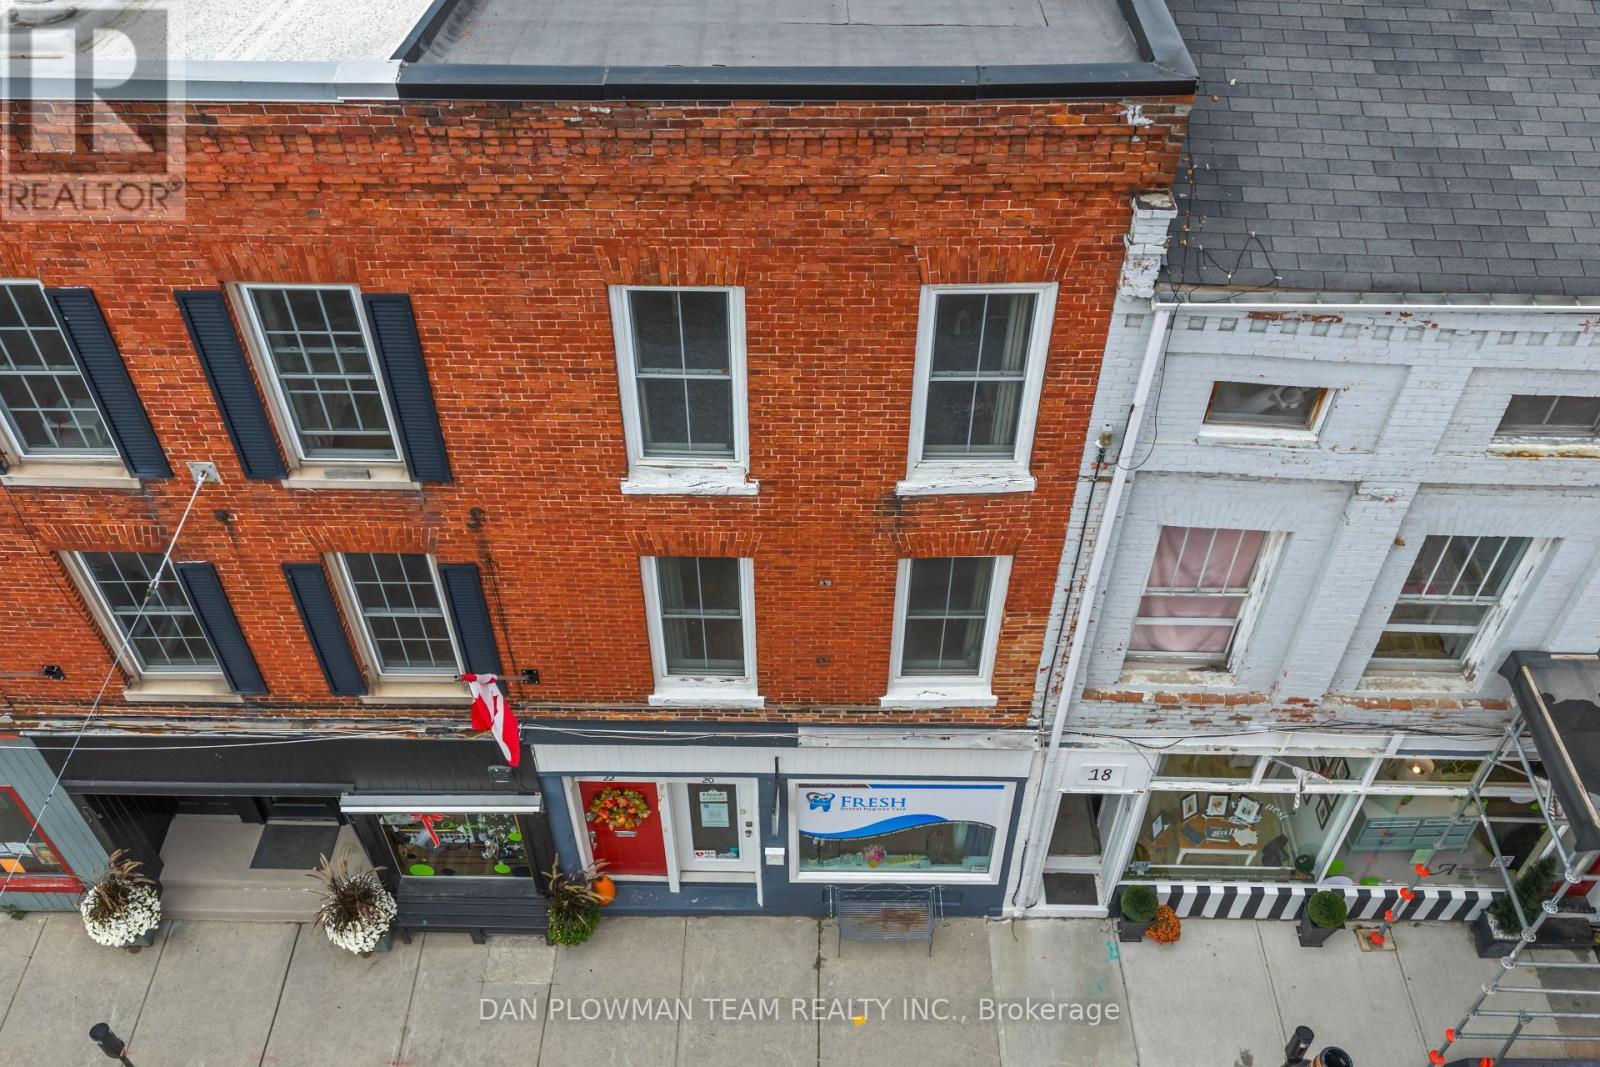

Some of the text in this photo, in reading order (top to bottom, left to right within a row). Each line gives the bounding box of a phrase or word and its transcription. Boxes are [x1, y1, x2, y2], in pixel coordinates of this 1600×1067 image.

[702, 776, 715, 784] 20
[1087, 768, 1113, 782] 18
[841, 796, 906, 808] FRESH
